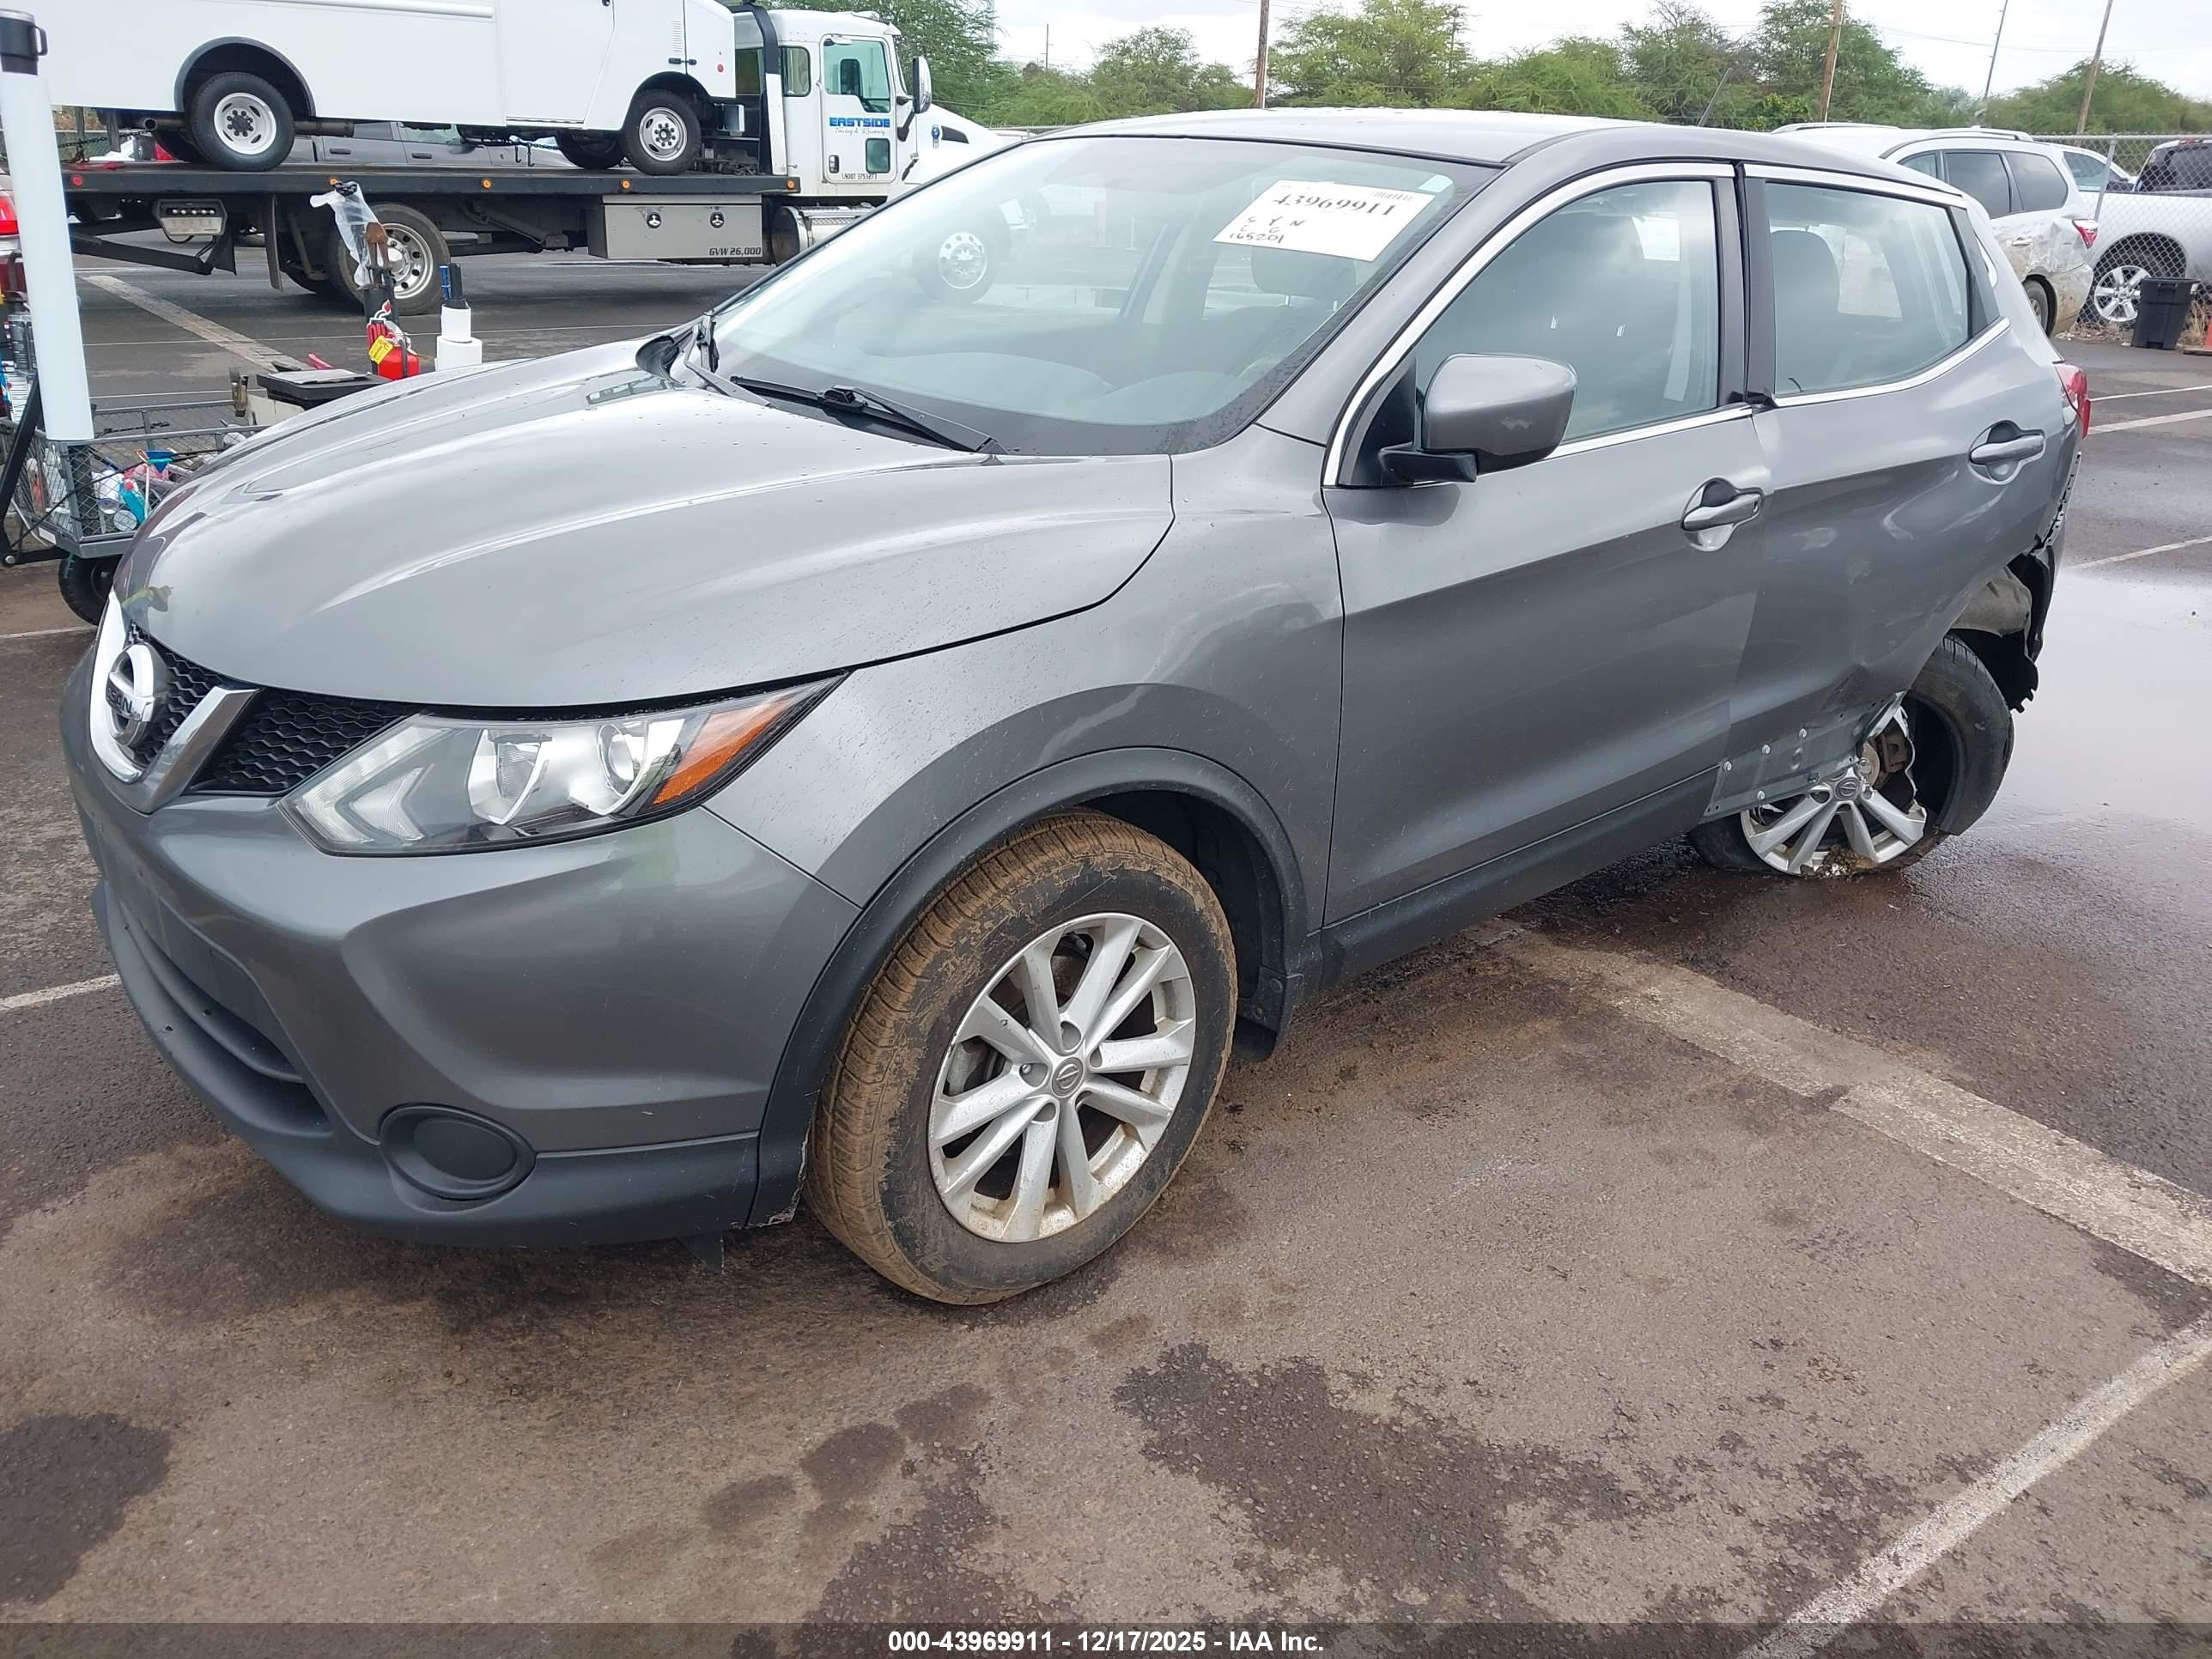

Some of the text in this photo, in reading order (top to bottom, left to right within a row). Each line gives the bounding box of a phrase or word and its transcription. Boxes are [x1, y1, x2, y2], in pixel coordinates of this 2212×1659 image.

[830, 117, 890, 127] EASTSIDE
[1273, 194, 1396, 216] 43969911
[709, 247, 729, 256] GVW
